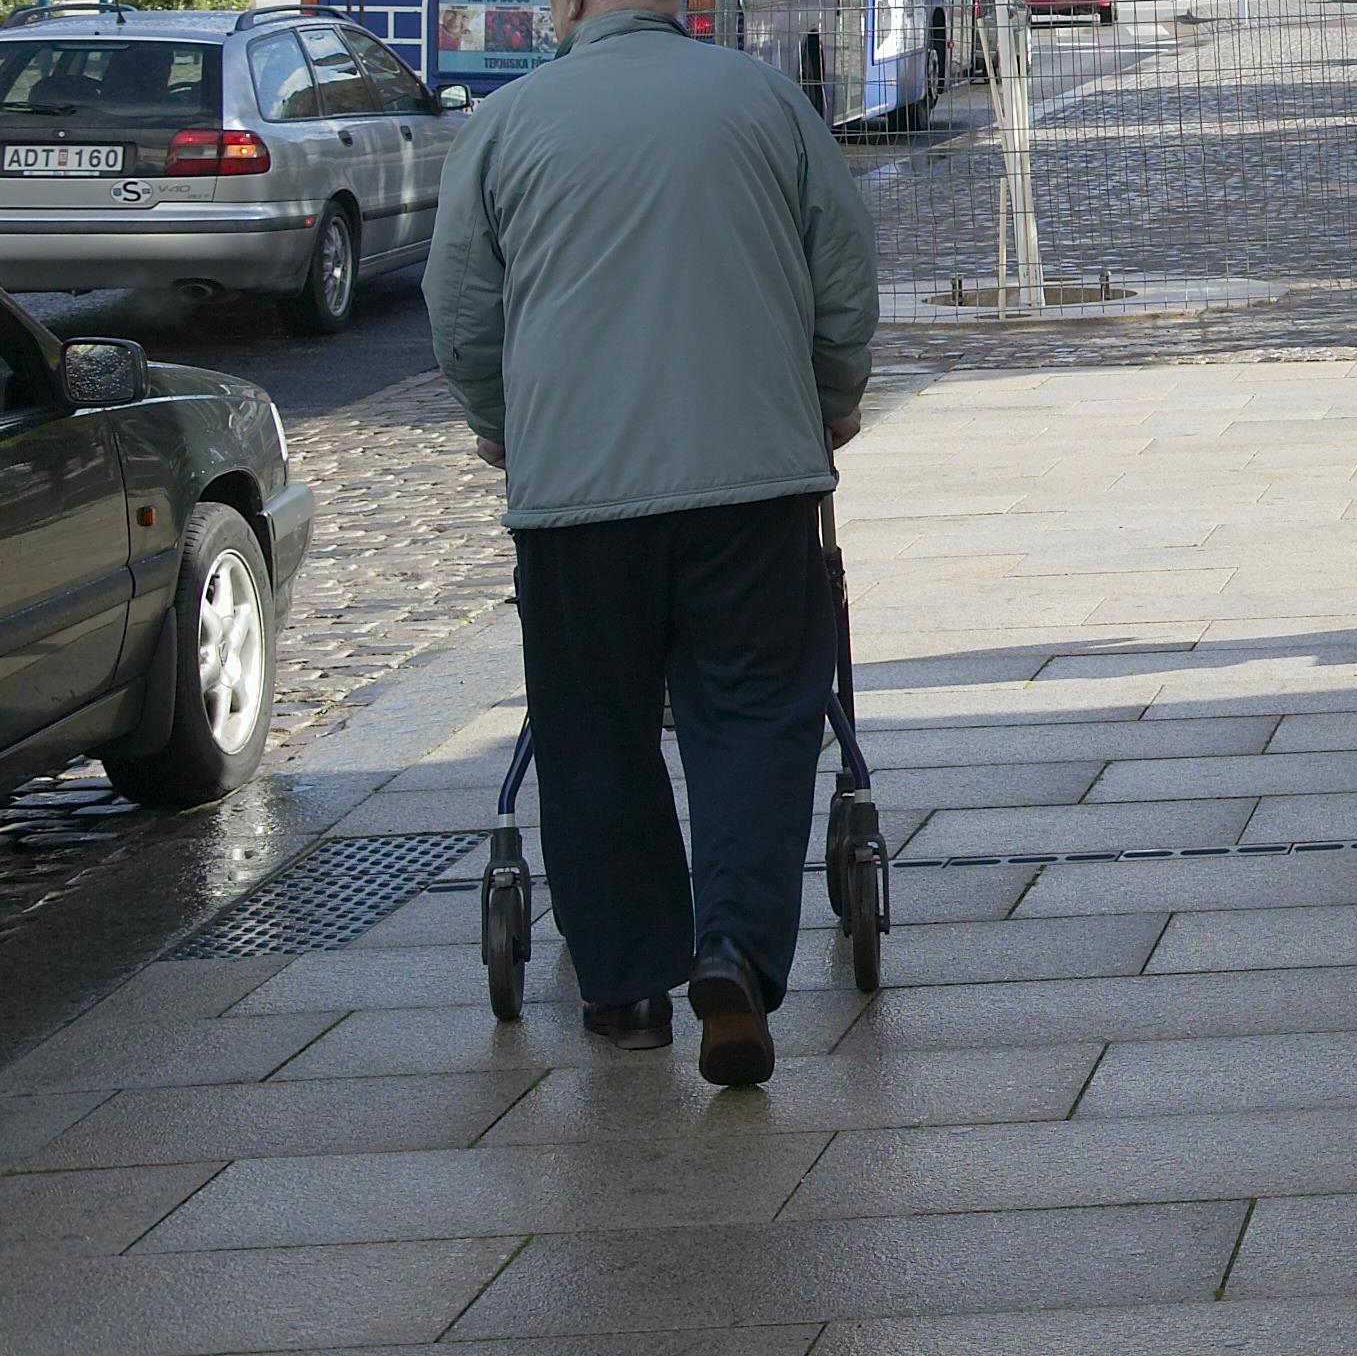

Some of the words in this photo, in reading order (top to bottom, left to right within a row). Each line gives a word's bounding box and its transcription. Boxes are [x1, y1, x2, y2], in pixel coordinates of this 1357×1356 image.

[8, 148, 54, 167] ADT
[74, 148, 119, 167] 160
[122, 180, 142, 202] S
[158, 184, 192, 193] V40
